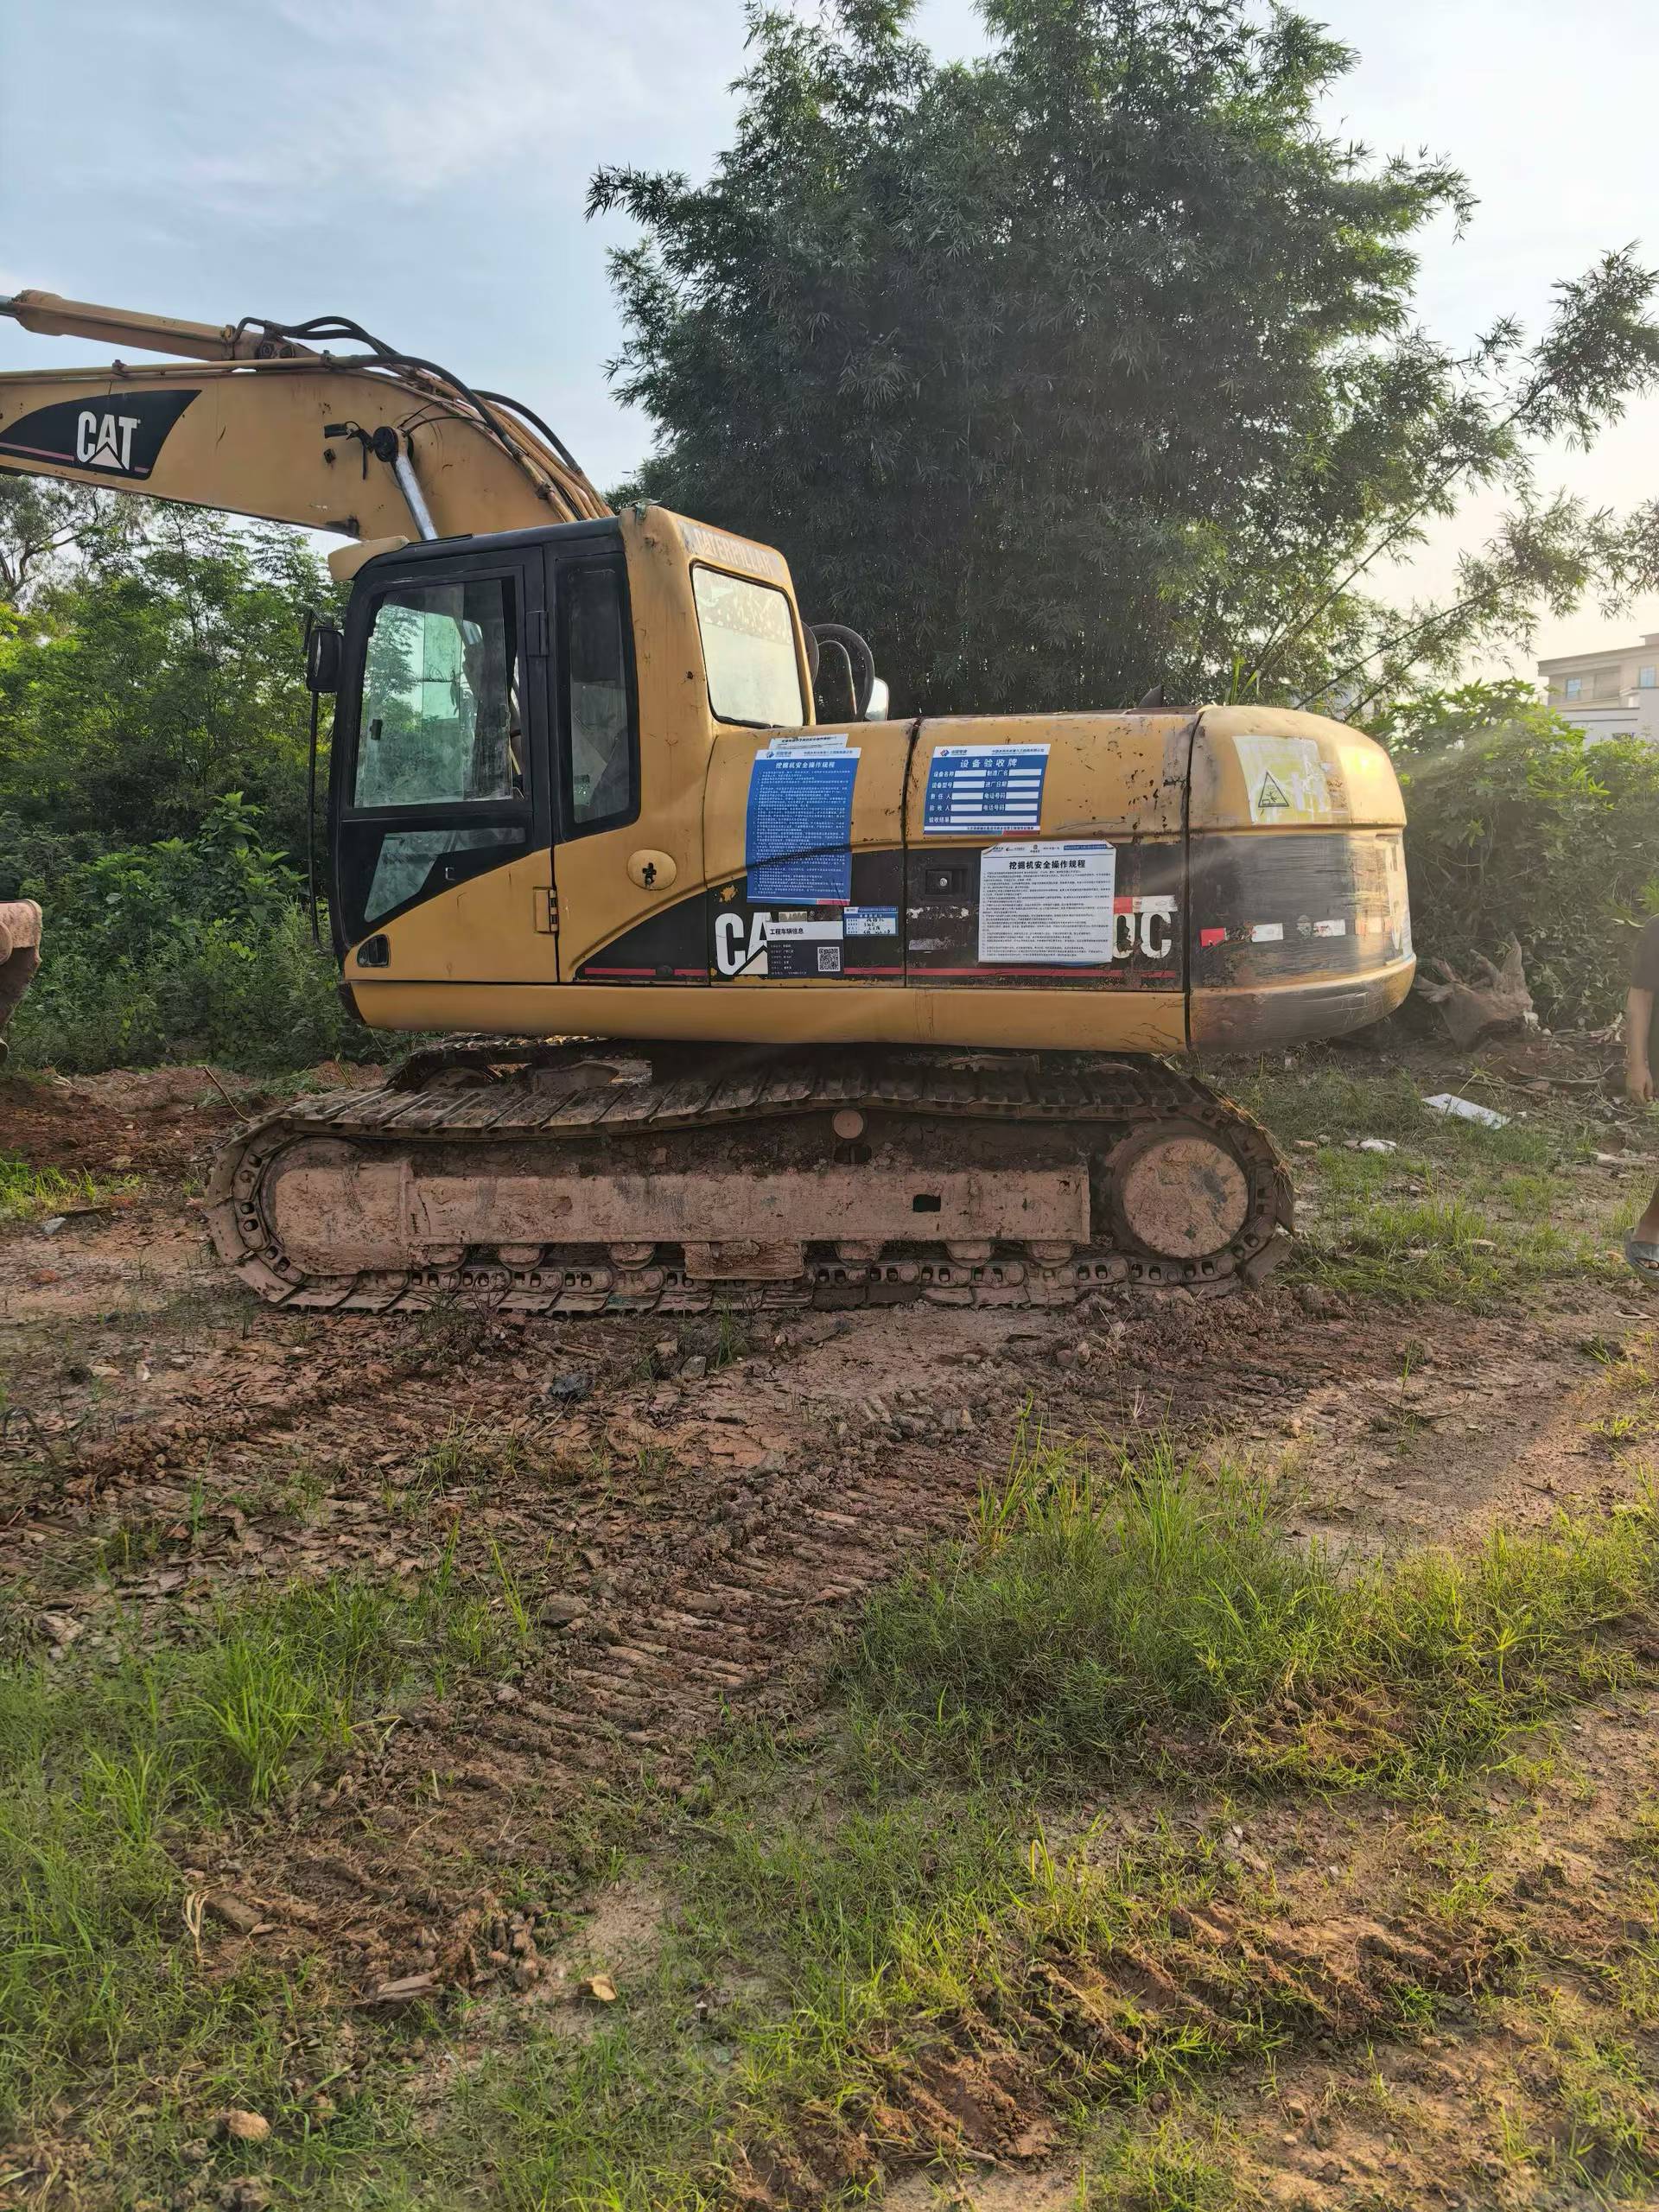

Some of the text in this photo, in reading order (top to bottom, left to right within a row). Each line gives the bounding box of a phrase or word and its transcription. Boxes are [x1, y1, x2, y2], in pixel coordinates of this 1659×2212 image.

[77, 411, 138, 470] CAT
[693, 527, 774, 577] CATERPILLAR
[960, 759, 1018, 768] 设备验收牌
[1008, 859, 1086, 870] 挖掘机安全操作规程
[770, 927, 804, 936] 工程车辆信息
